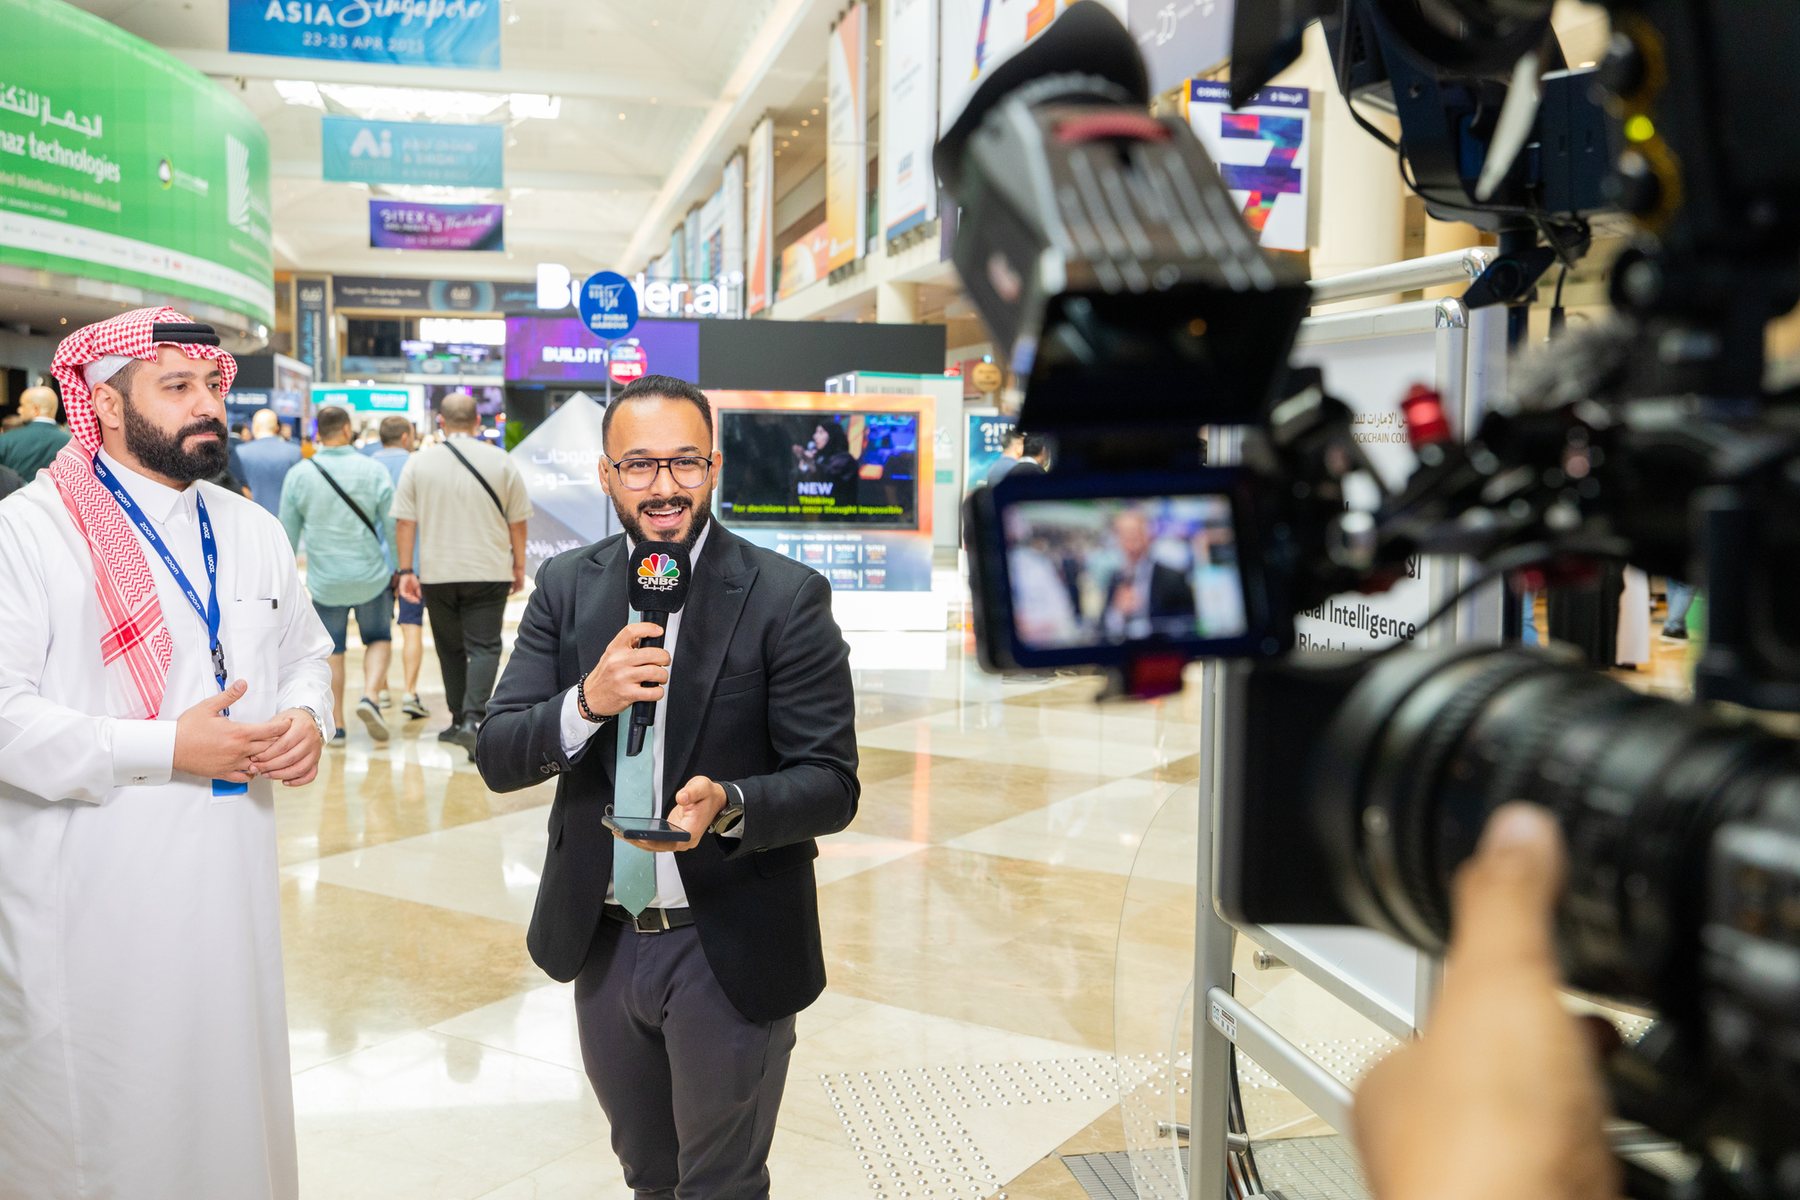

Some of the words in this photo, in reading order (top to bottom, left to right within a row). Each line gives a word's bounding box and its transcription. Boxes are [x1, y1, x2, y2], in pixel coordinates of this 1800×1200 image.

[264, 2, 335, 26] ASIA
[29, 132, 121, 184] technologies
[1353, 432, 1389, 444] OCKCHAIN
[114, 489, 132, 508] zoom
[797, 482, 833, 495] NEW
[140, 521, 156, 541] zoom
[165, 555, 180, 575] zoom
[207, 554, 215, 574] zoom
[637, 576, 679, 586] CNBC
[187, 590, 201, 610] zoom
[1329, 599, 1416, 640] Intelligence
